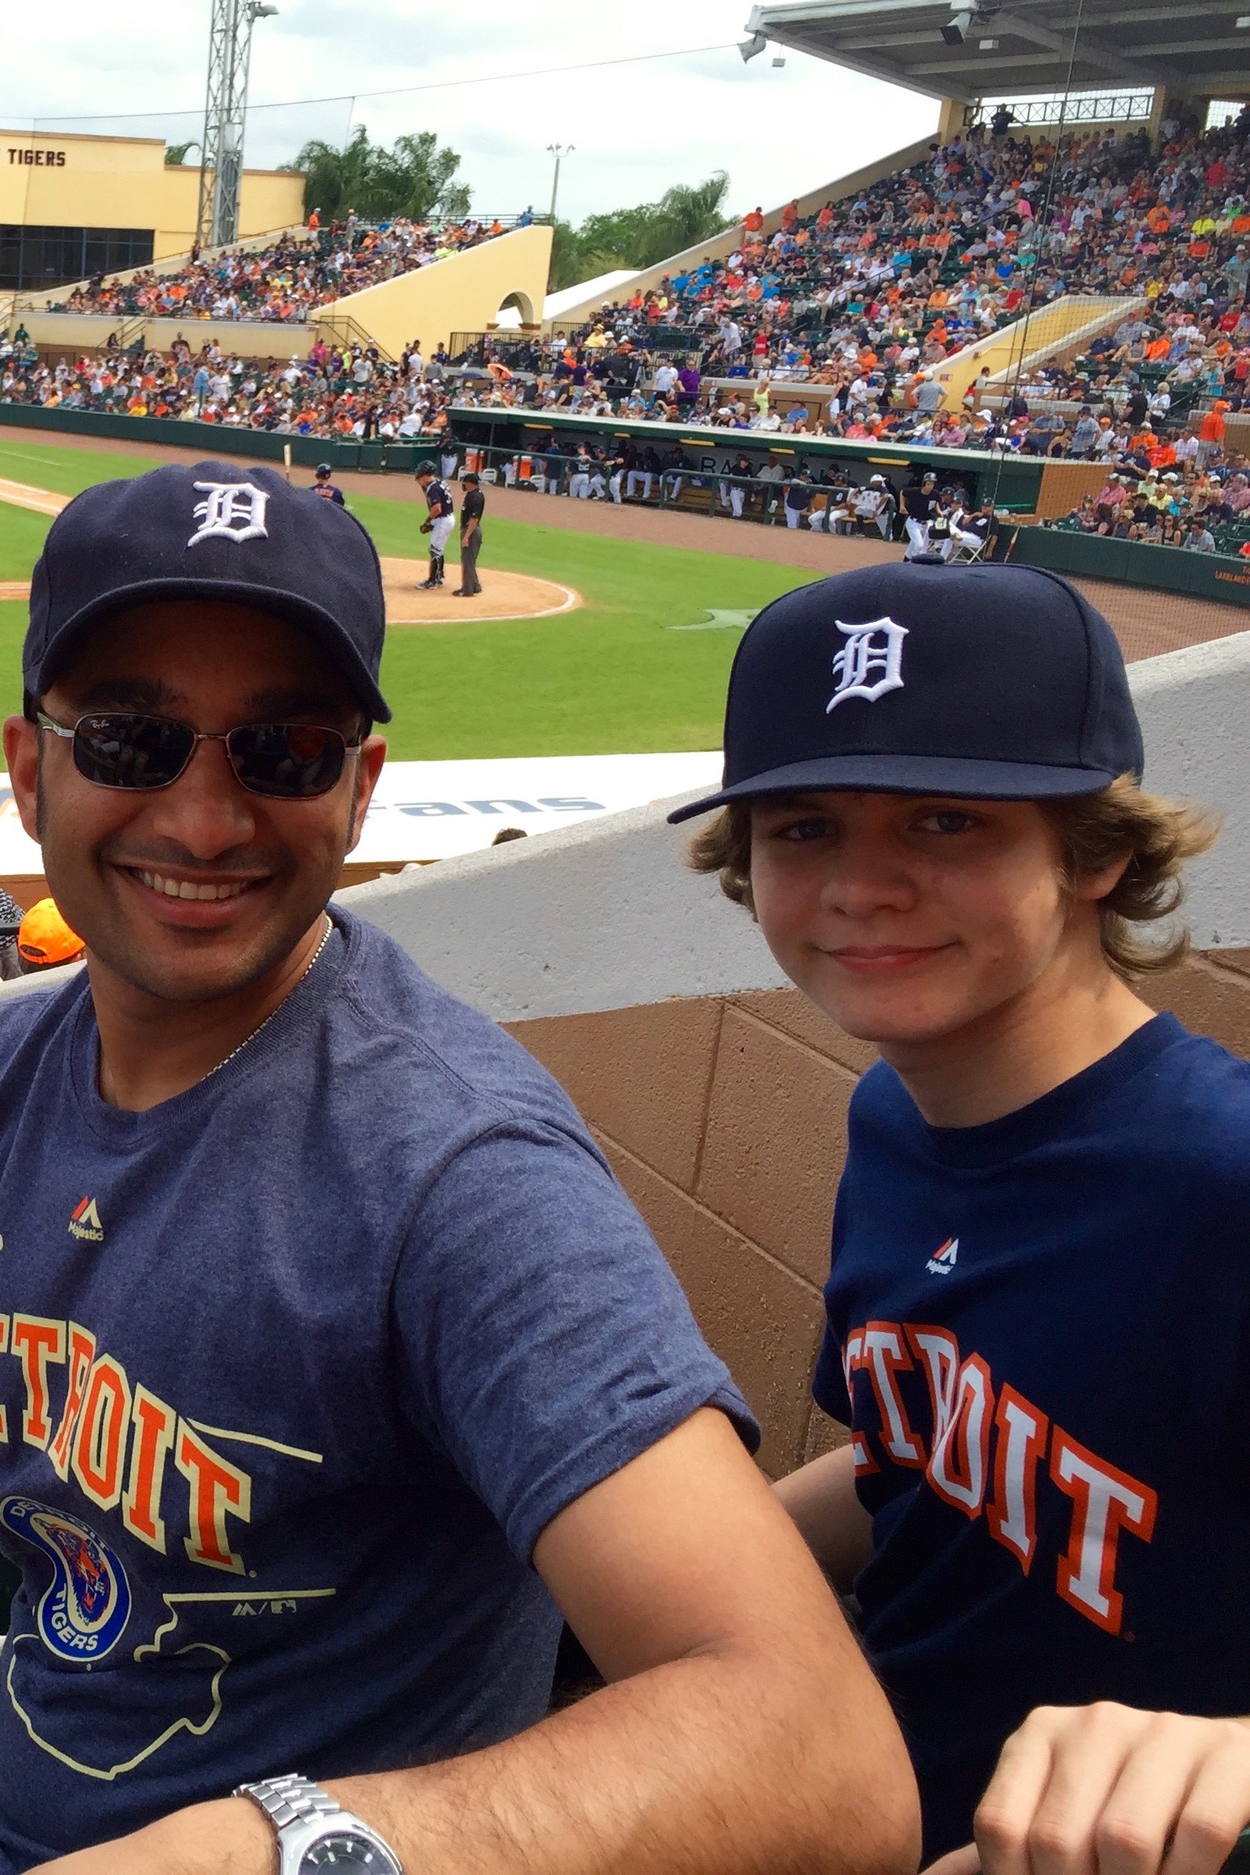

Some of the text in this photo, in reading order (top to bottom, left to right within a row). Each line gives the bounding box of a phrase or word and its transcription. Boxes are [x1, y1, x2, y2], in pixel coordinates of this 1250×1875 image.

[7, 148, 66, 167] TIGERS
[187, 481, 271, 547] D
[826, 616, 910, 714] D
[68, 1220, 104, 1241] Majestic
[51, 1583, 99, 1652] TIGERS
